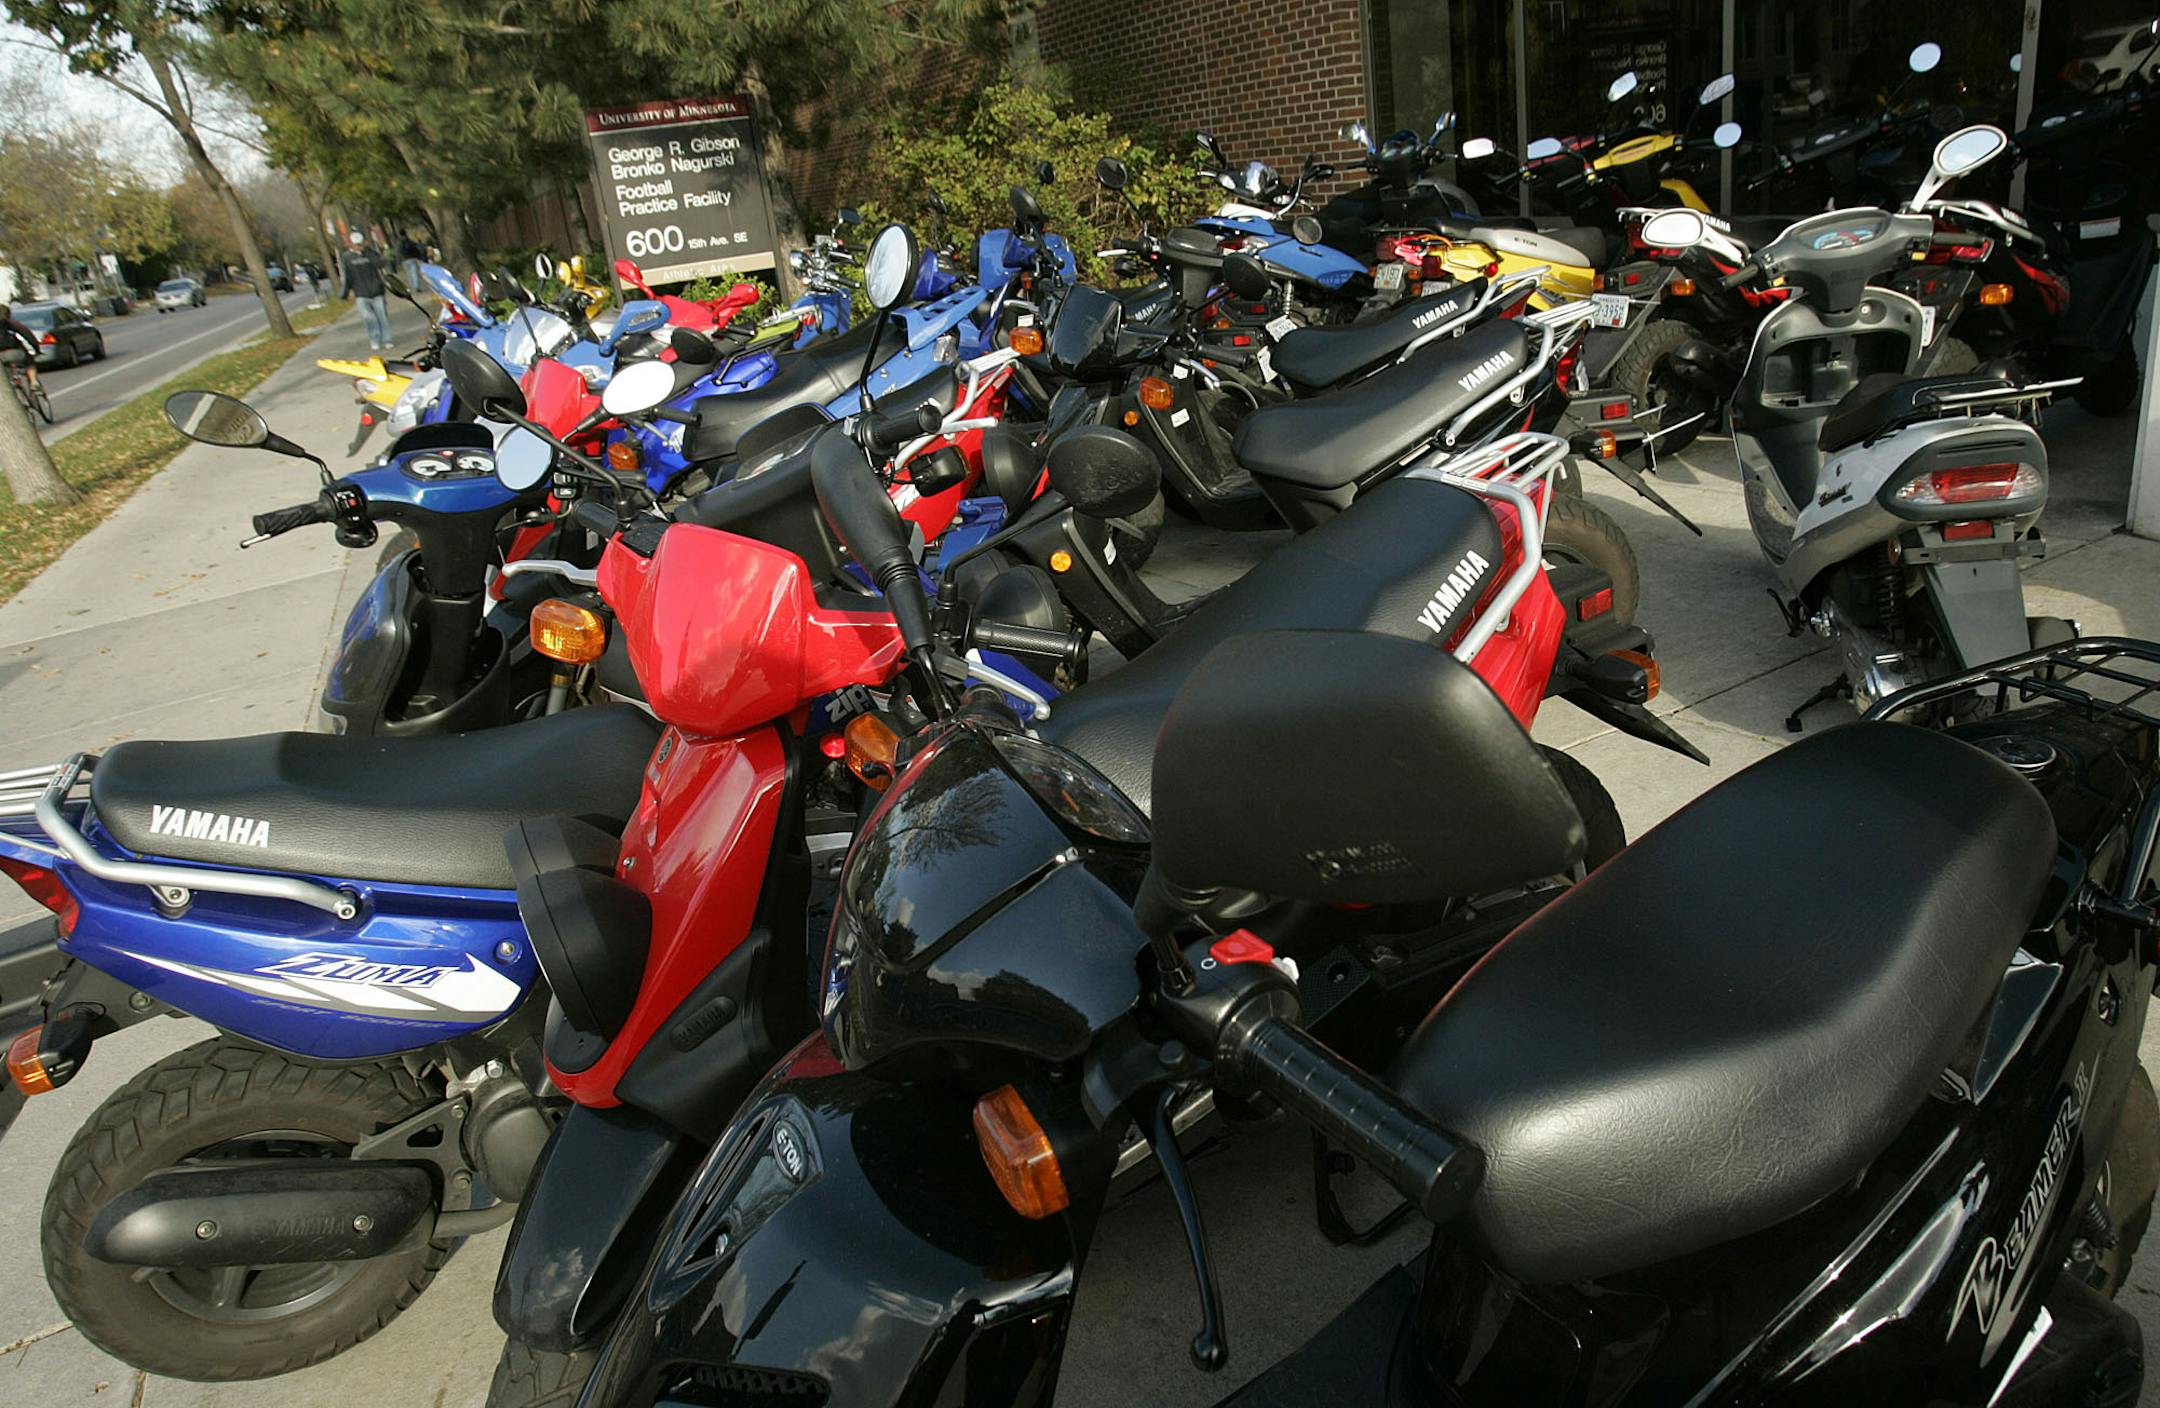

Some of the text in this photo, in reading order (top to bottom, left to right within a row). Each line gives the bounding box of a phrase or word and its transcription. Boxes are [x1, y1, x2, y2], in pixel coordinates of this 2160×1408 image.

[608, 136, 740, 163] George R. Gibson
[611, 153, 735, 180] Bronko Nagurski
[615, 180, 674, 201] Football
[618, 190, 731, 217] Practice Facility
[626, 224, 684, 257] 600
[710, 236, 729, 247] Ave.
[734, 231, 748, 243] SE
[1412, 299, 1459, 329] YAMAHA
[1458, 350, 1515, 392] YAMAHA
[1417, 549, 1490, 634] YAMAHA
[150, 804, 270, 848] YAMAHA
[254, 951, 460, 988] ZUMA
[776, 1127, 802, 1176] E-TON
[271, 1217, 345, 1237] YAMAHA
[1946, 1096, 2082, 1344] BEAMER
